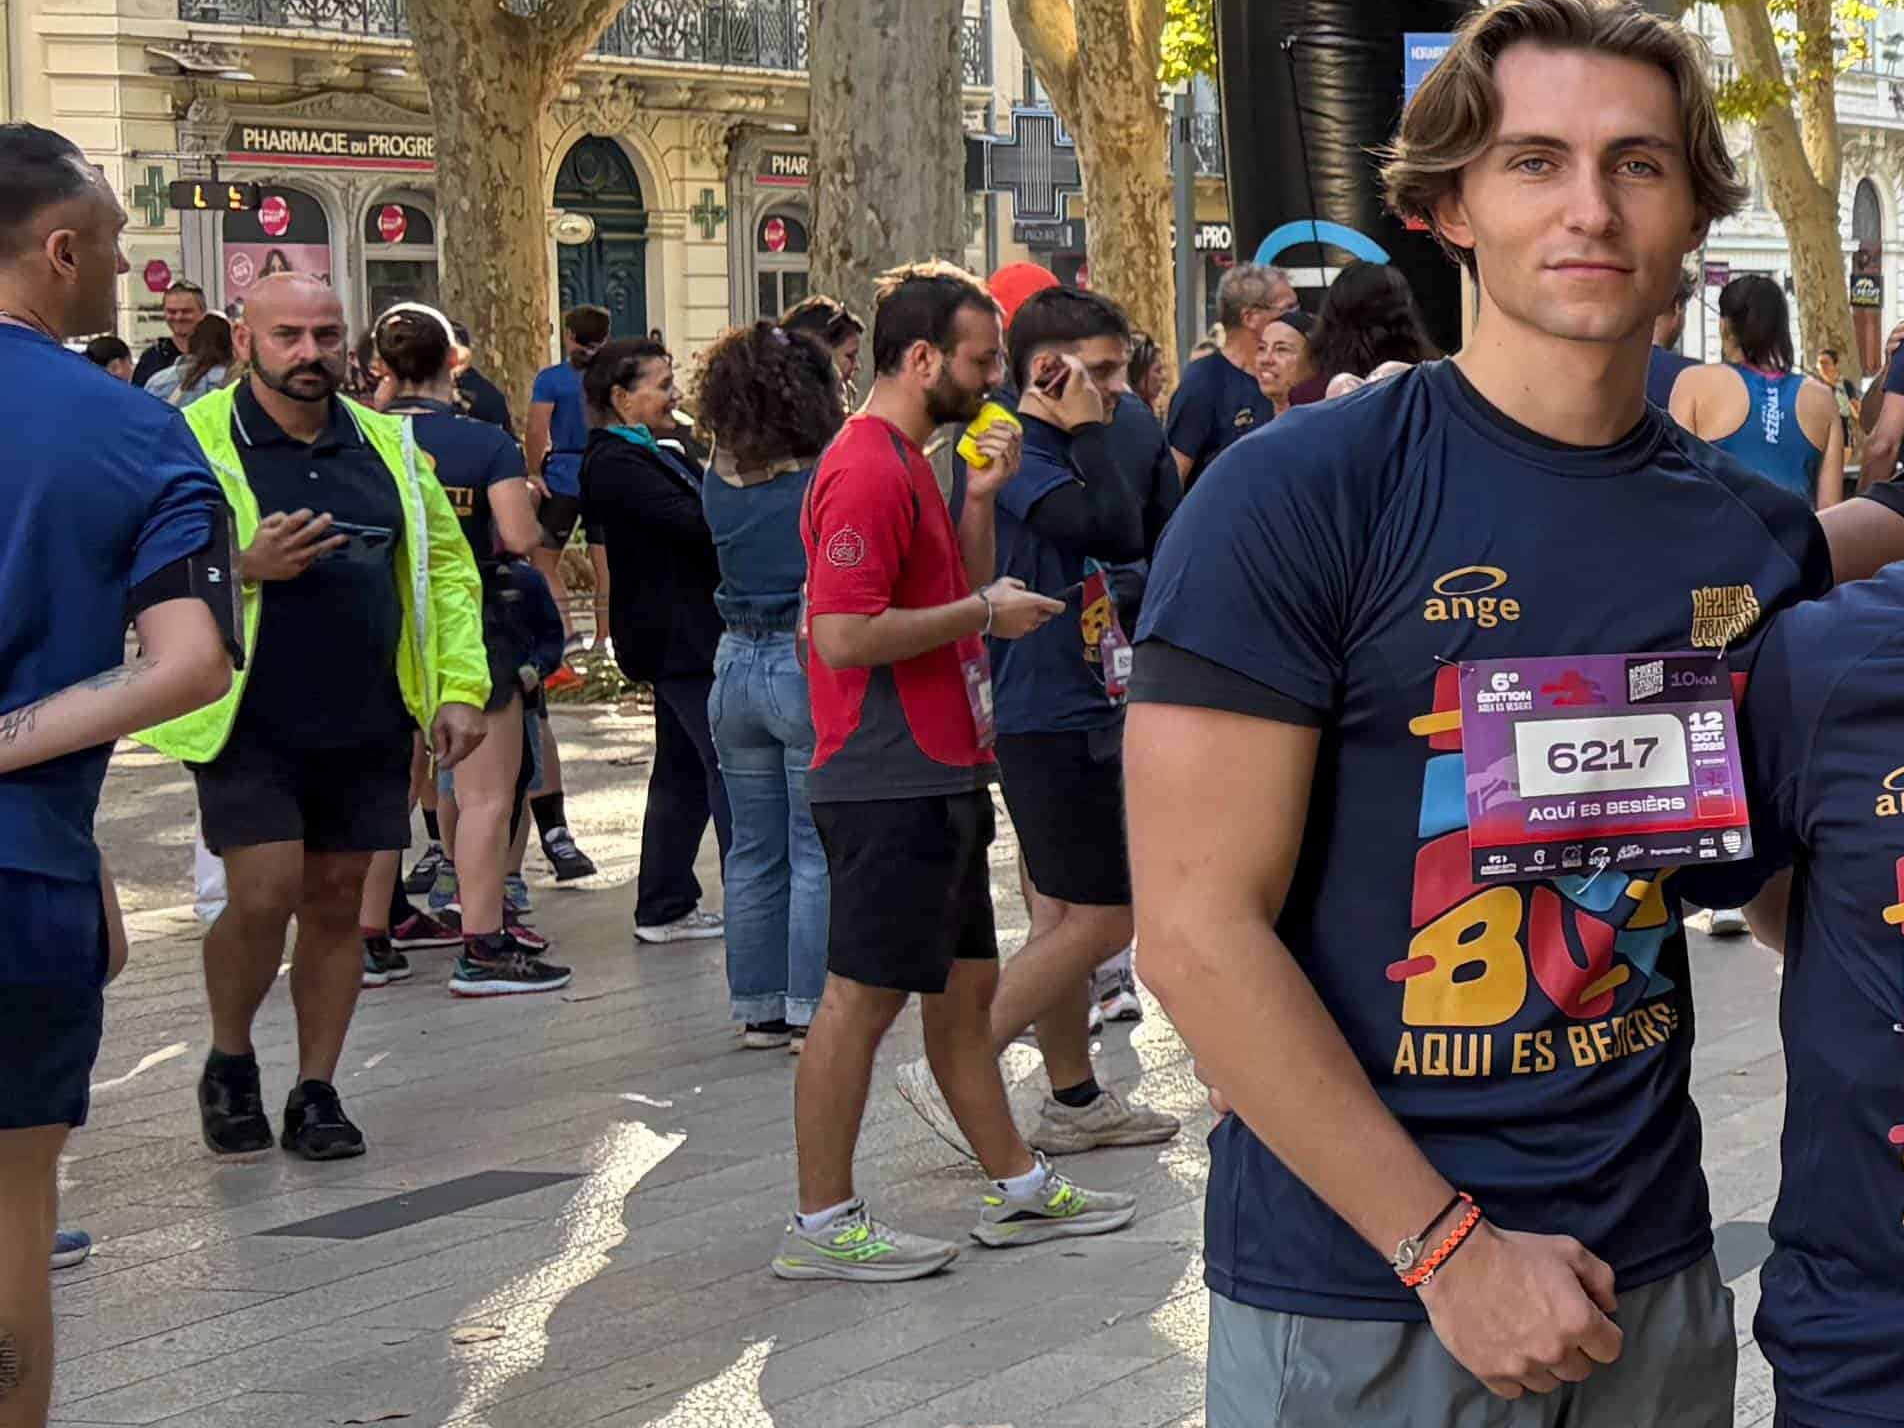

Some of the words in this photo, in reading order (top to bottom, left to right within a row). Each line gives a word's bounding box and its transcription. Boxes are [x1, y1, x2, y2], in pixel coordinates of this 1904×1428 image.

[243, 128, 348, 153] PHARMACIE
[1423, 596, 1521, 628] ange
[1477, 690, 1532, 704] ÉDITION
[1689, 712, 1724, 731] 12
[1547, 737, 1658, 774] 6217
[1528, 801, 1575, 821] AQUÍ
[1581, 802, 1601, 816] ES
[1393, 1031, 1492, 1077] AQUI
[1511, 1031, 1555, 1074] ES
